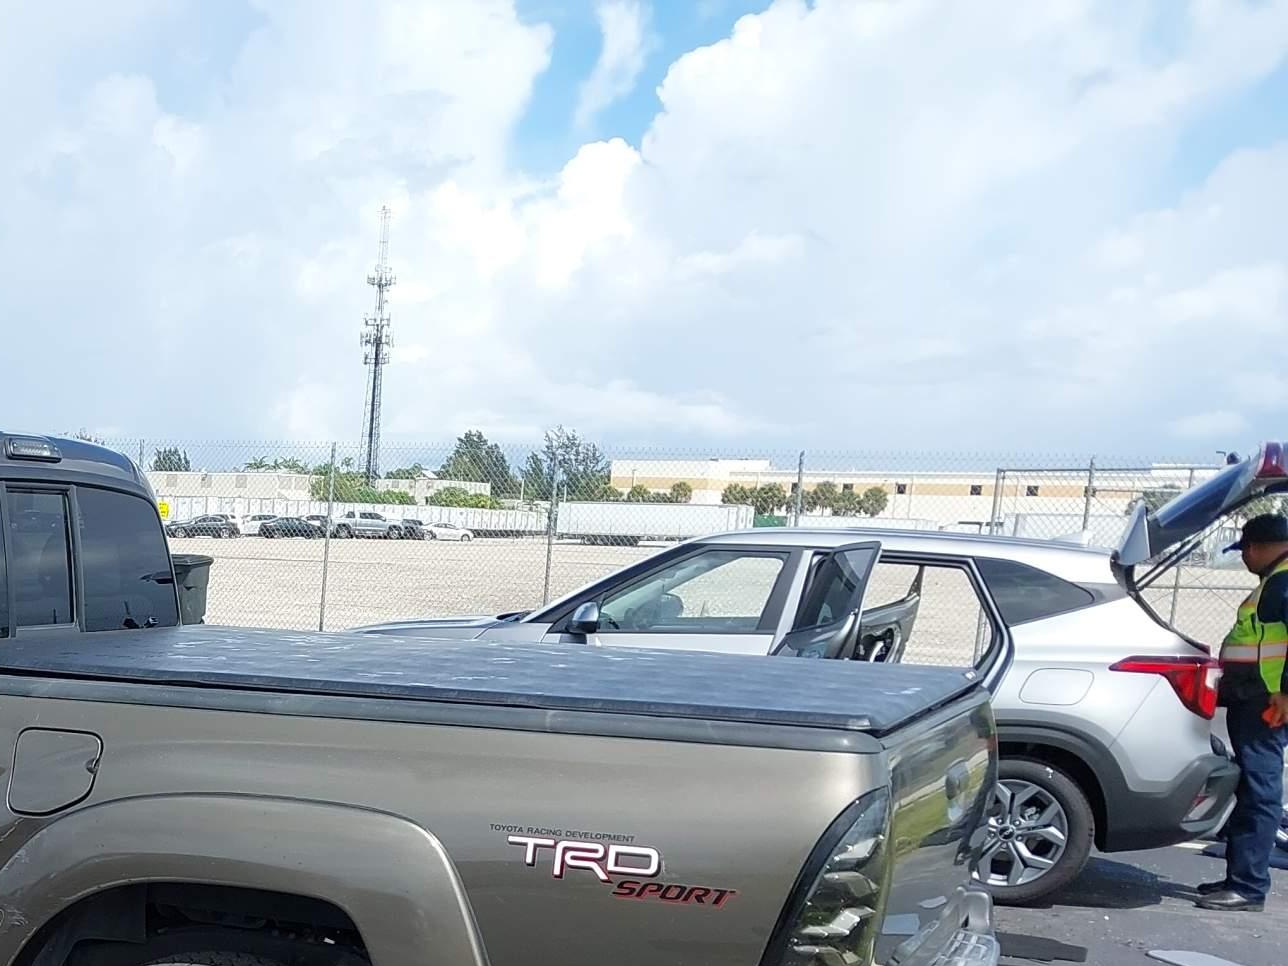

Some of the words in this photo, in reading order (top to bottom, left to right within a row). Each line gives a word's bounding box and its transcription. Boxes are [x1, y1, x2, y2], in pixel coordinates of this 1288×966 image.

[490, 823, 524, 833] TOYOTA
[527, 827, 562, 837] RACING
[565, 830, 635, 842] DEVELOPMENT
[507, 835, 662, 884] TRD
[612, 880, 739, 909] SPORT
